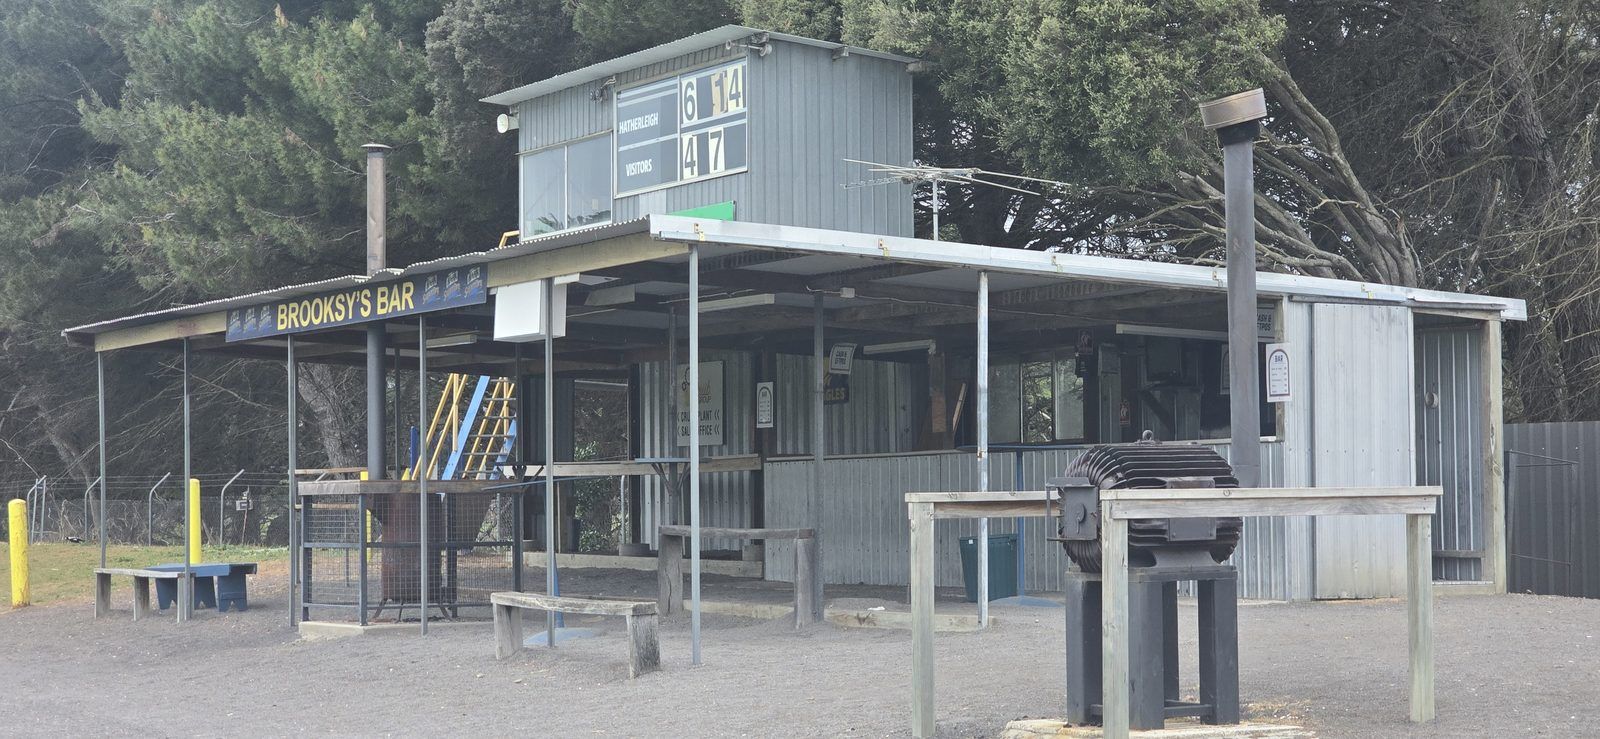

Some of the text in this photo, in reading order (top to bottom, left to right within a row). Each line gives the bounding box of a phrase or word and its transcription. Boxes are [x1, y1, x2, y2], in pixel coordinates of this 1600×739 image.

[618, 112, 659, 134] HATHERLEIGH
[684, 81, 696, 121] 6
[625, 130, 722, 177] VISITORS 4 7
[277, 288, 372, 331] BROOKSY'S
[376, 281, 415, 315] BAR
